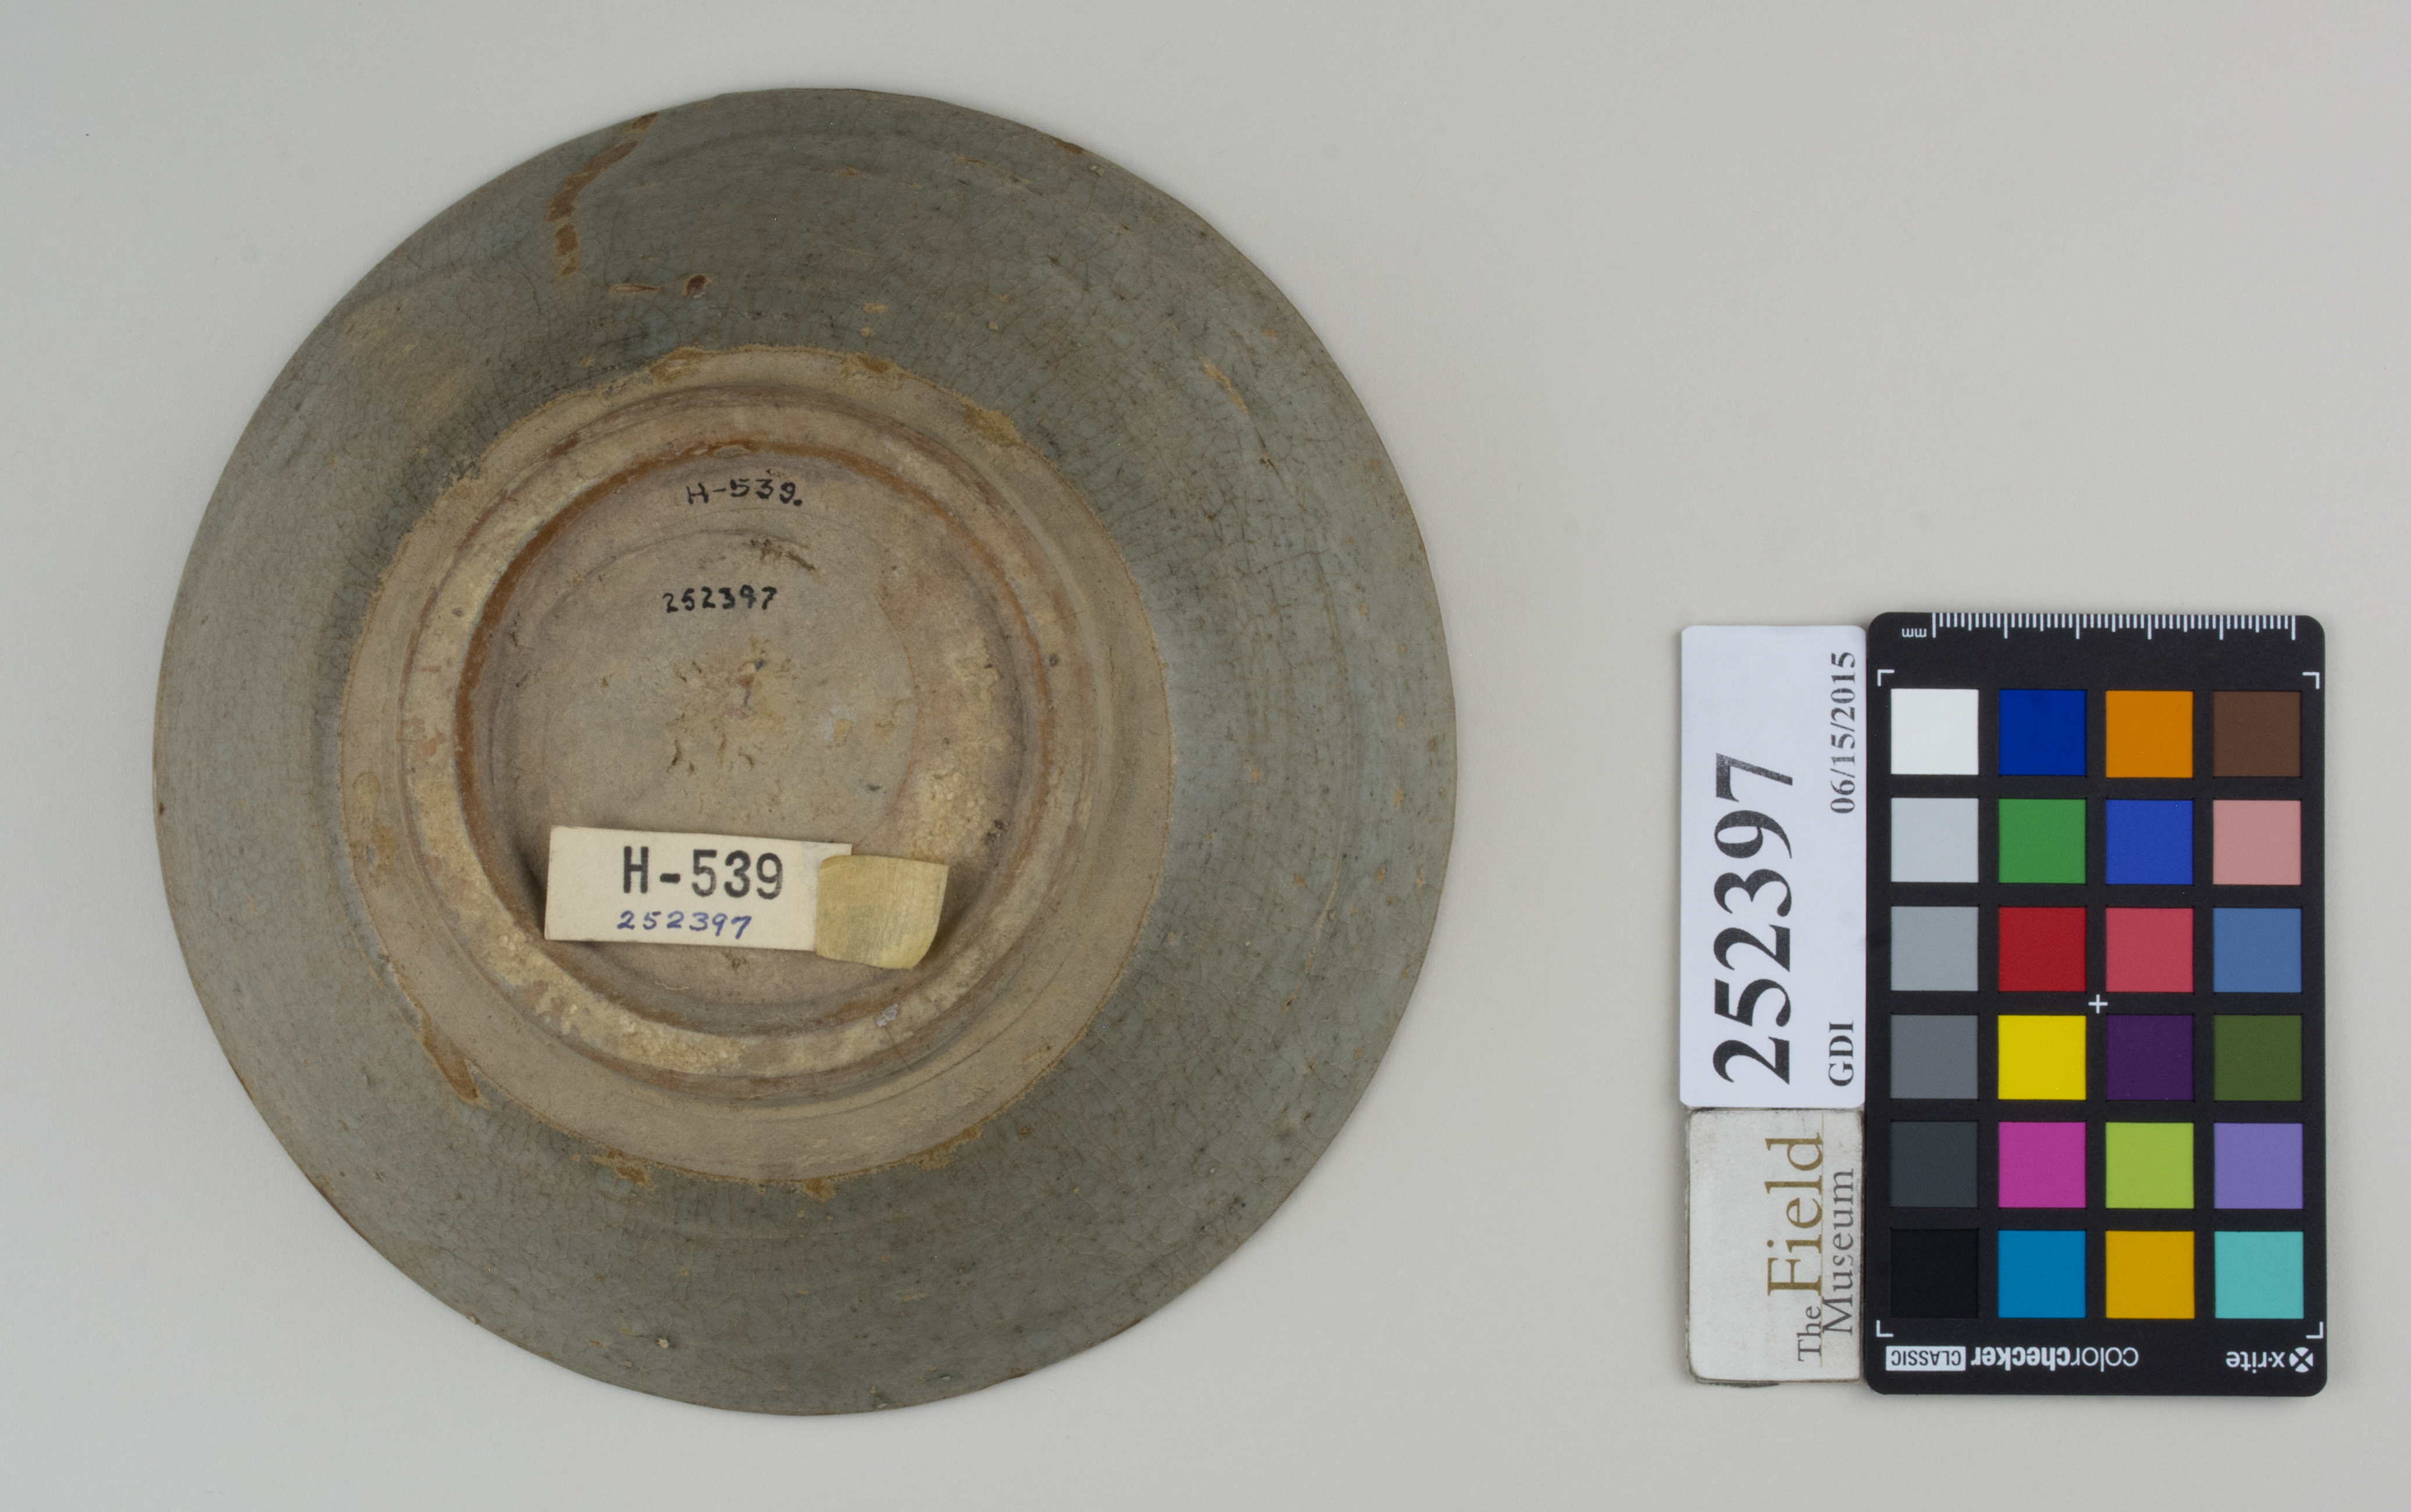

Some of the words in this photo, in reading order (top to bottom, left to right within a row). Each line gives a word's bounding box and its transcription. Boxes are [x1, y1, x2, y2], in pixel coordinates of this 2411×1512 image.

[662, 584, 777, 613] 252397
[1901, 628, 1927, 637] mm
[1830, 651, 1856, 814] 06/15/2015
[622, 846, 783, 900] H-539
[617, 911, 752, 940] 252397
[1713, 753, 1793, 1085] 252397
[1828, 1021, 1854, 1087] GDI
[1764, 1132, 1824, 1296] Field
[1821, 1168, 1853, 1336] Museum
[1797, 1306, 1821, 1361] The
[1891, 1349, 1962, 1367] CLASSIC
[1971, 1346, 2139, 1372] colorchecker
